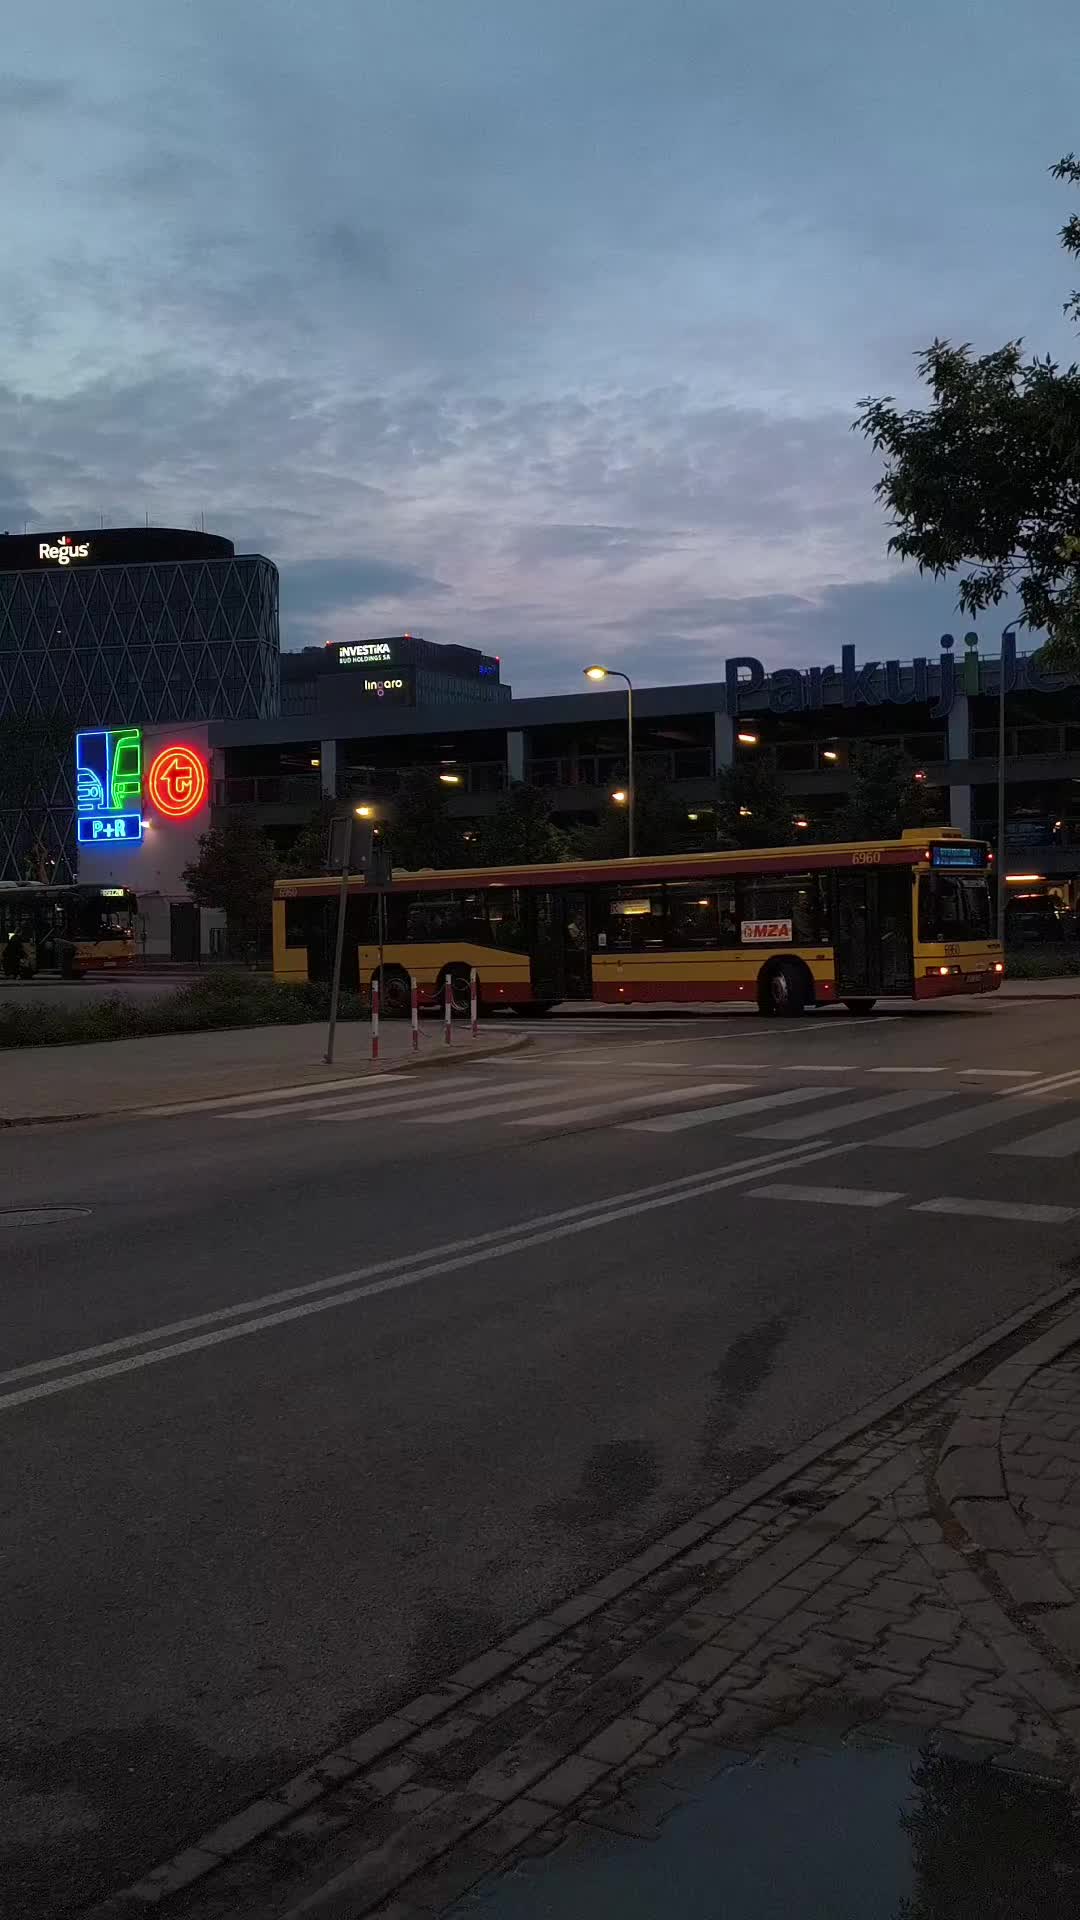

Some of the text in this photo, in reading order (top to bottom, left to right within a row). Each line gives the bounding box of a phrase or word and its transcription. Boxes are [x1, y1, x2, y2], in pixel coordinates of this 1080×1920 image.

[352, 655, 381, 663] HOLDINGS
[726, 633, 955, 718] Parkuj
[965, 632, 978, 696] i
[364, 679, 403, 697] lingaro
[92, 819, 126, 839] P+R
[852, 852, 880, 865] 6960
[753, 923, 789, 938] MZA
